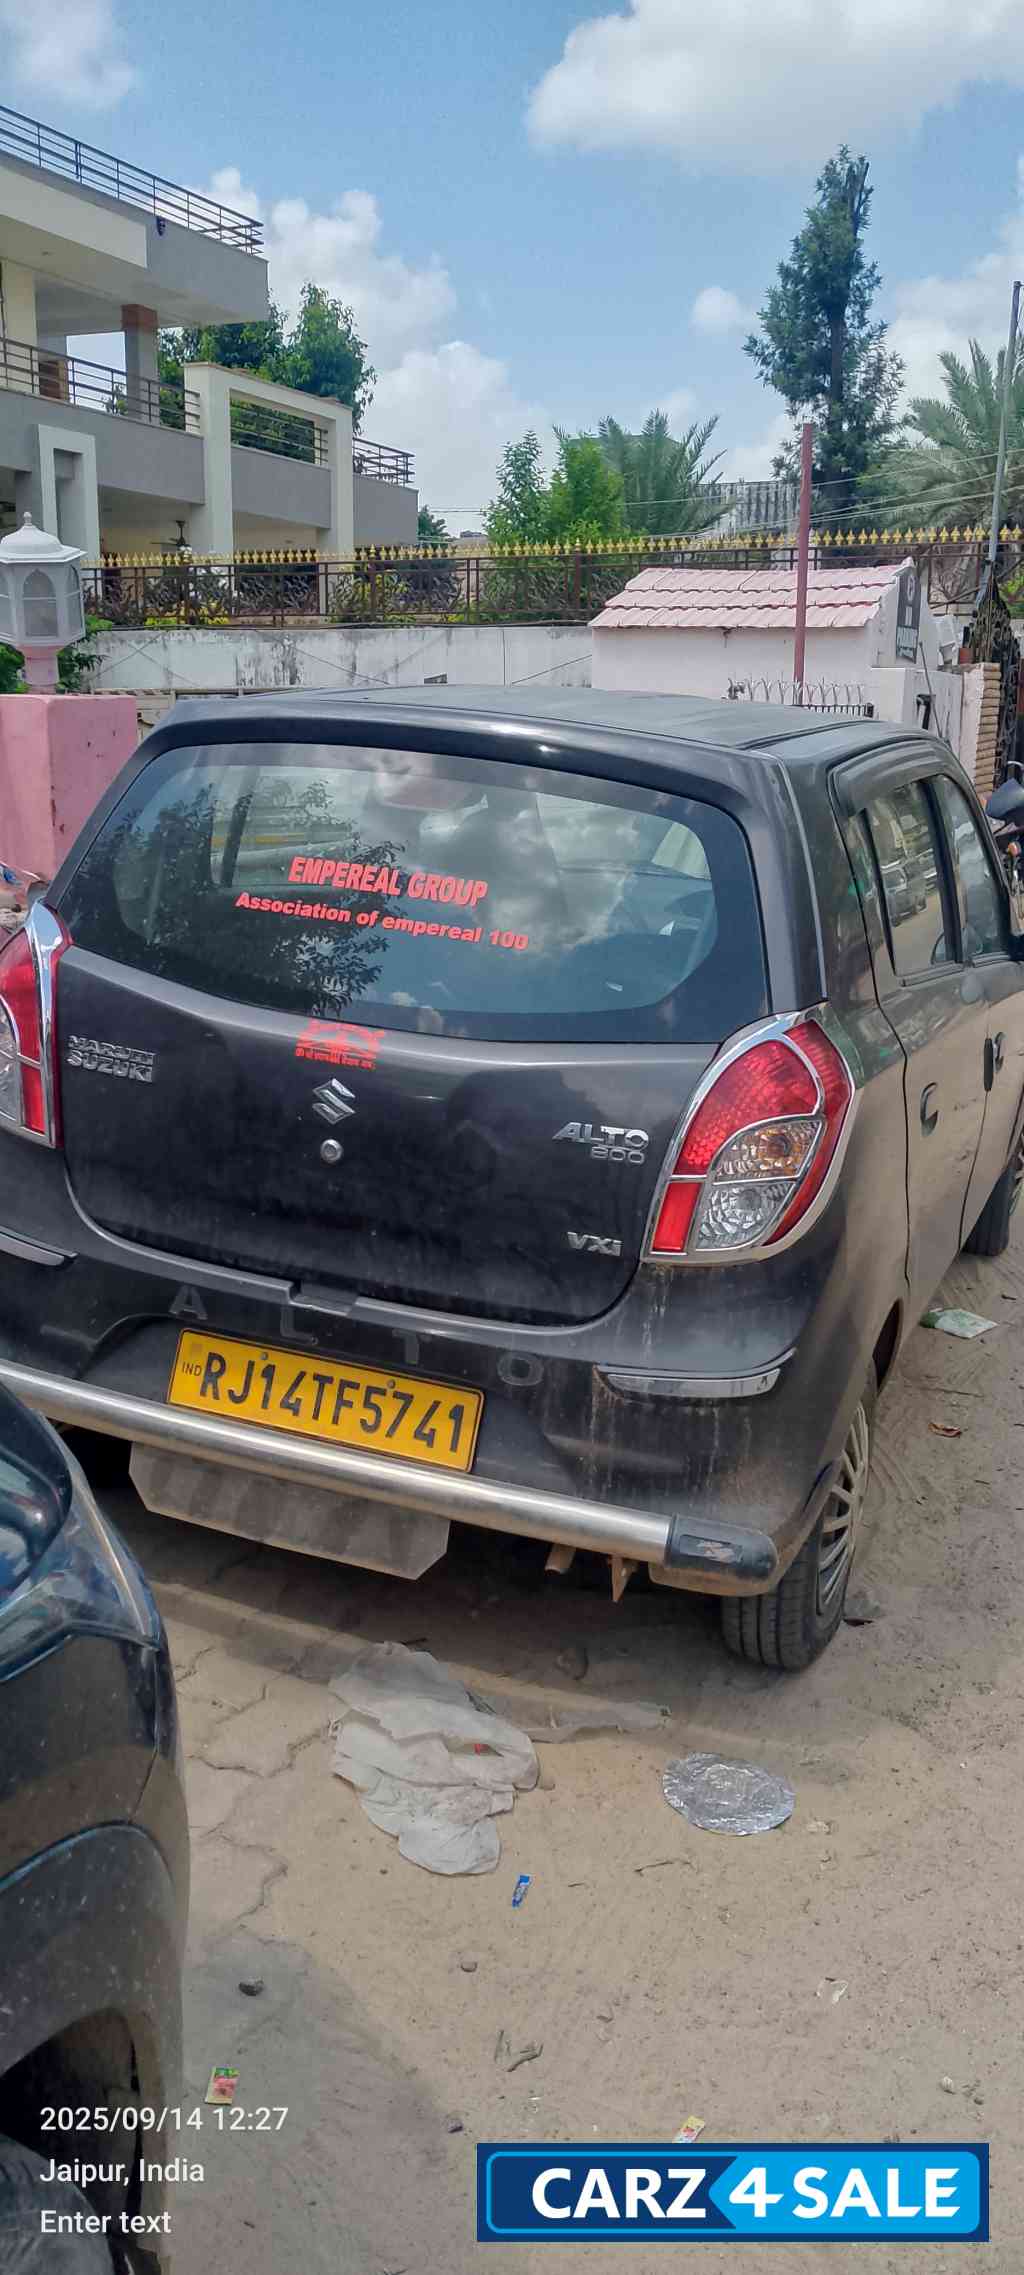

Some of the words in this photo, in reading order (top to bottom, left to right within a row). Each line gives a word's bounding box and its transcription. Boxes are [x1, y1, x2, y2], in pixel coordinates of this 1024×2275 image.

[288, 857, 400, 896] EMPEREAL
[407, 870, 488, 906] GROUP
[235, 891, 351, 922] Association
[356, 910, 379, 927] of
[382, 917, 483, 943] empereal
[489, 930, 528, 950] 100
[67, 1035, 156, 1066] MARUTI
[67, 1049, 153, 1083] SUZUKI
[552, 1121, 649, 1151] ALTO
[590, 1146, 645, 1164] 800
[182, 1361, 202, 1377] IND
[199, 1351, 465, 1453] RJ14TF5741
